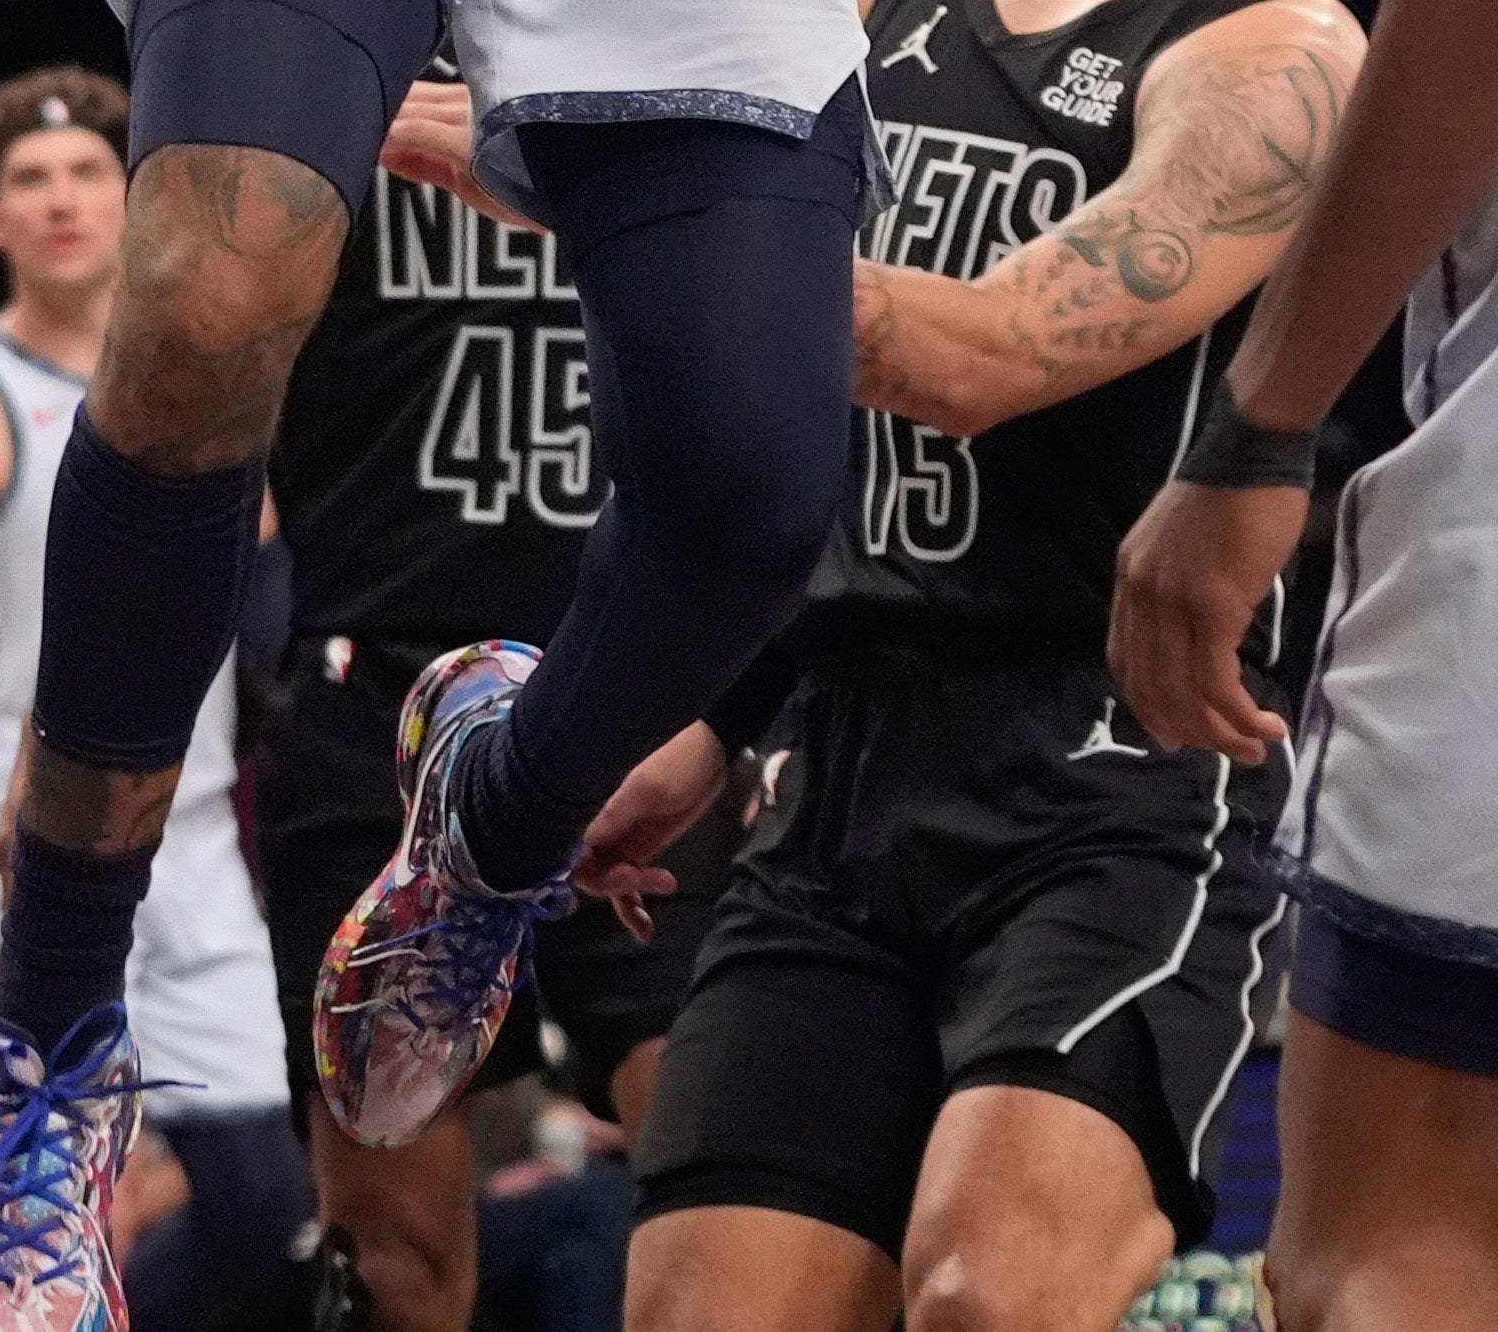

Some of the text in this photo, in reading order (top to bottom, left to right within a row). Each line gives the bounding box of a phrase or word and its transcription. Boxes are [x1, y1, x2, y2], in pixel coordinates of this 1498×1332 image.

[1068, 46, 1123, 79] GET
[1059, 64, 1125, 104] YOUR
[1040, 85, 1118, 127] GUIDE
[417, 325, 615, 528] 45
